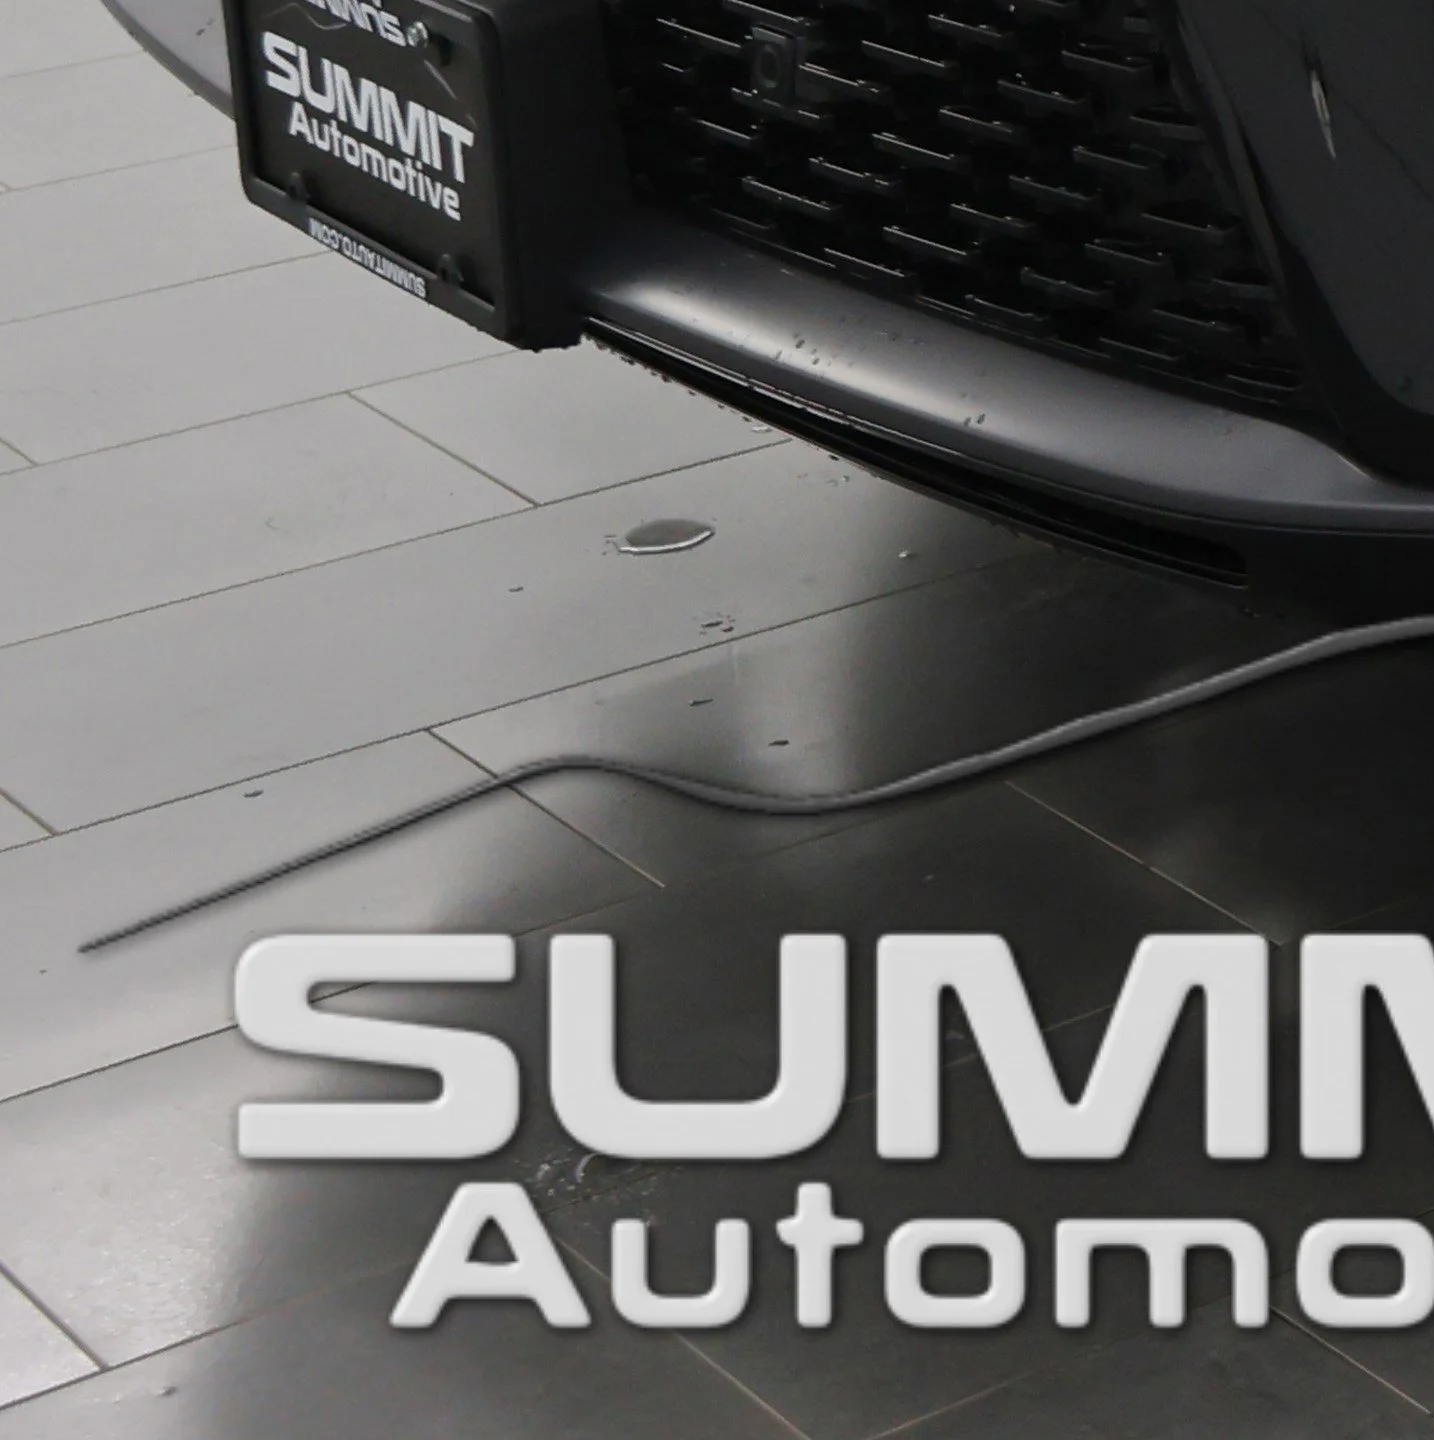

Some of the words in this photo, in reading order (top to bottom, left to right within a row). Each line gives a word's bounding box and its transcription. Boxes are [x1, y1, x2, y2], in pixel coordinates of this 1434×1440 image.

[262, 30, 474, 184] SUMMIT
[288, 102, 462, 222] Automotive
[308, 217, 427, 299] SUMMITAUTO.COM
